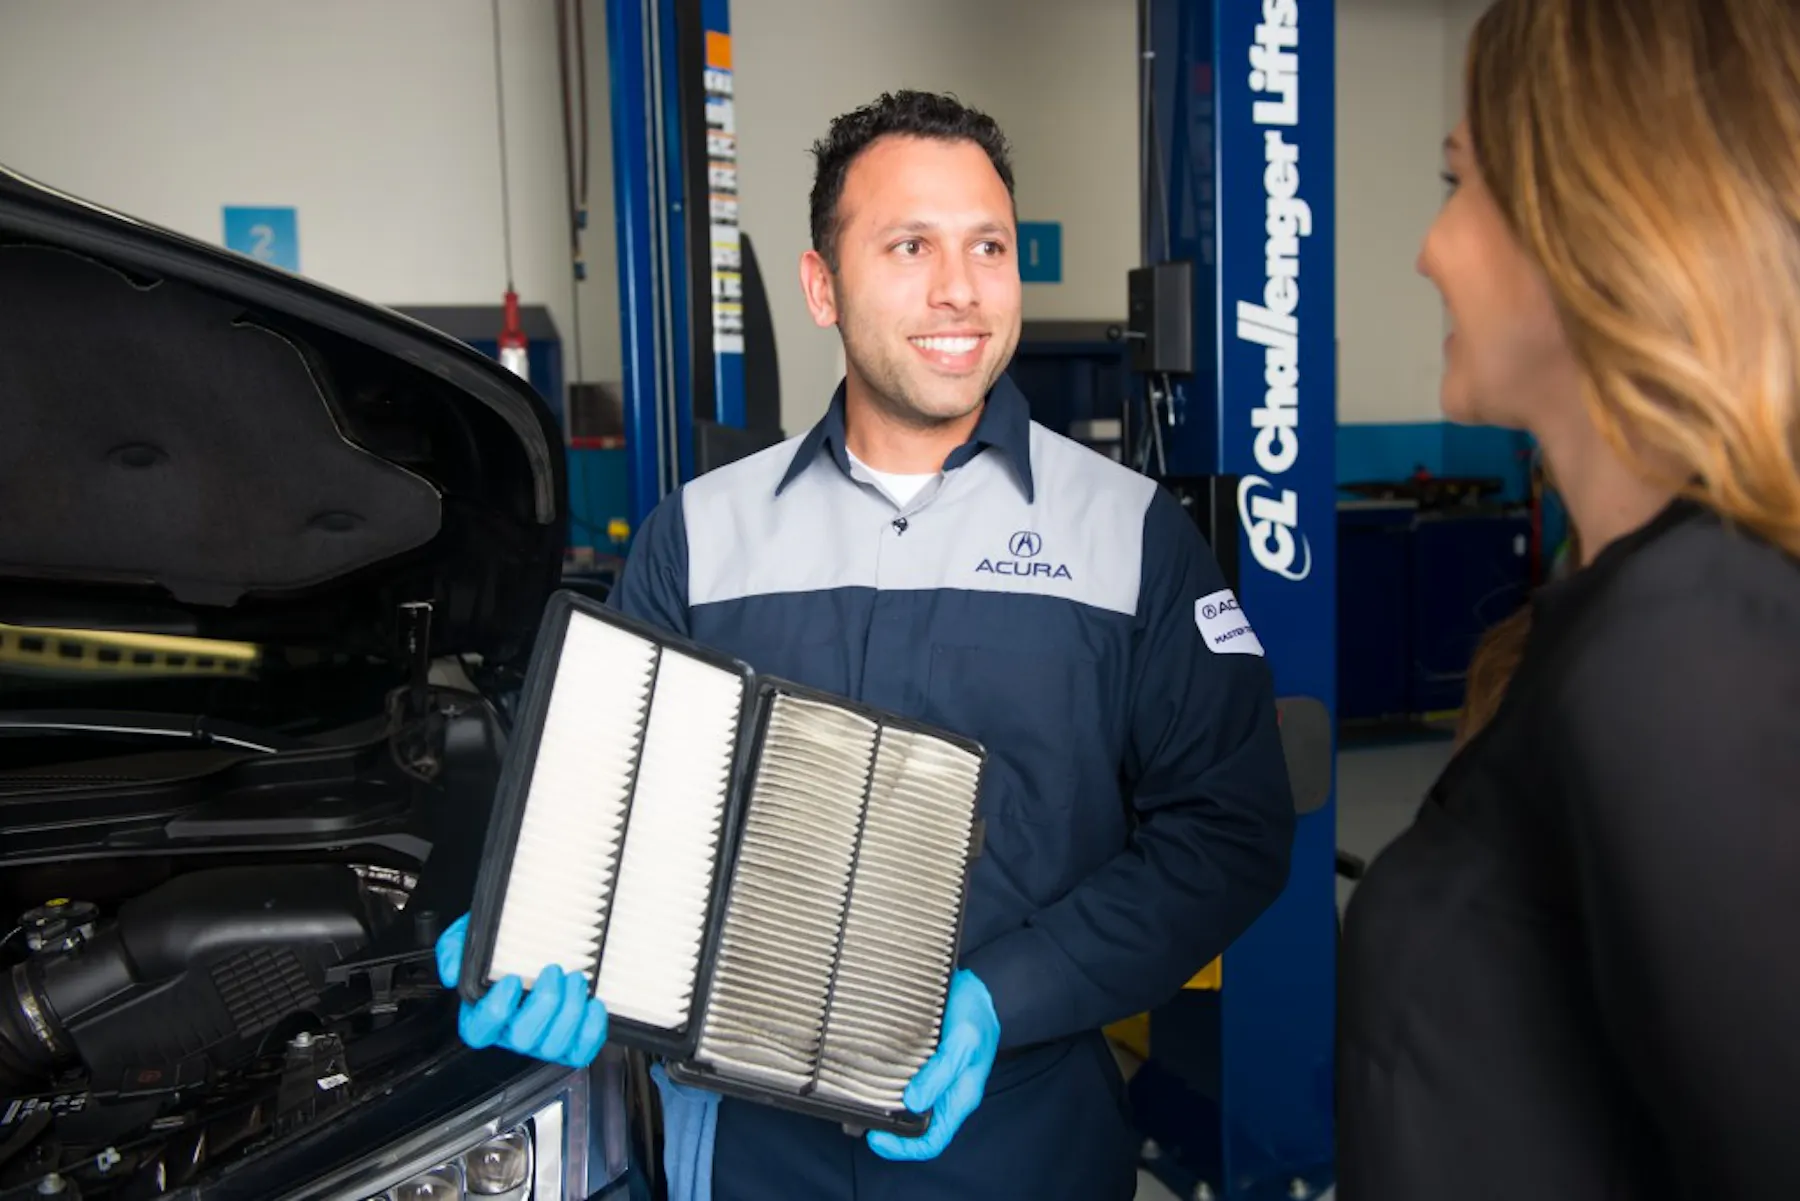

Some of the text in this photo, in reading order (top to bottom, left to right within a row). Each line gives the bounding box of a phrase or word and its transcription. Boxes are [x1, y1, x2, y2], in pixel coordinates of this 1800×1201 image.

[1248, 0, 1299, 126] Lifts
[249, 223, 276, 261] 2
[1237, 130, 1312, 473] Challenger
[975, 557, 1073, 581] ACURA
